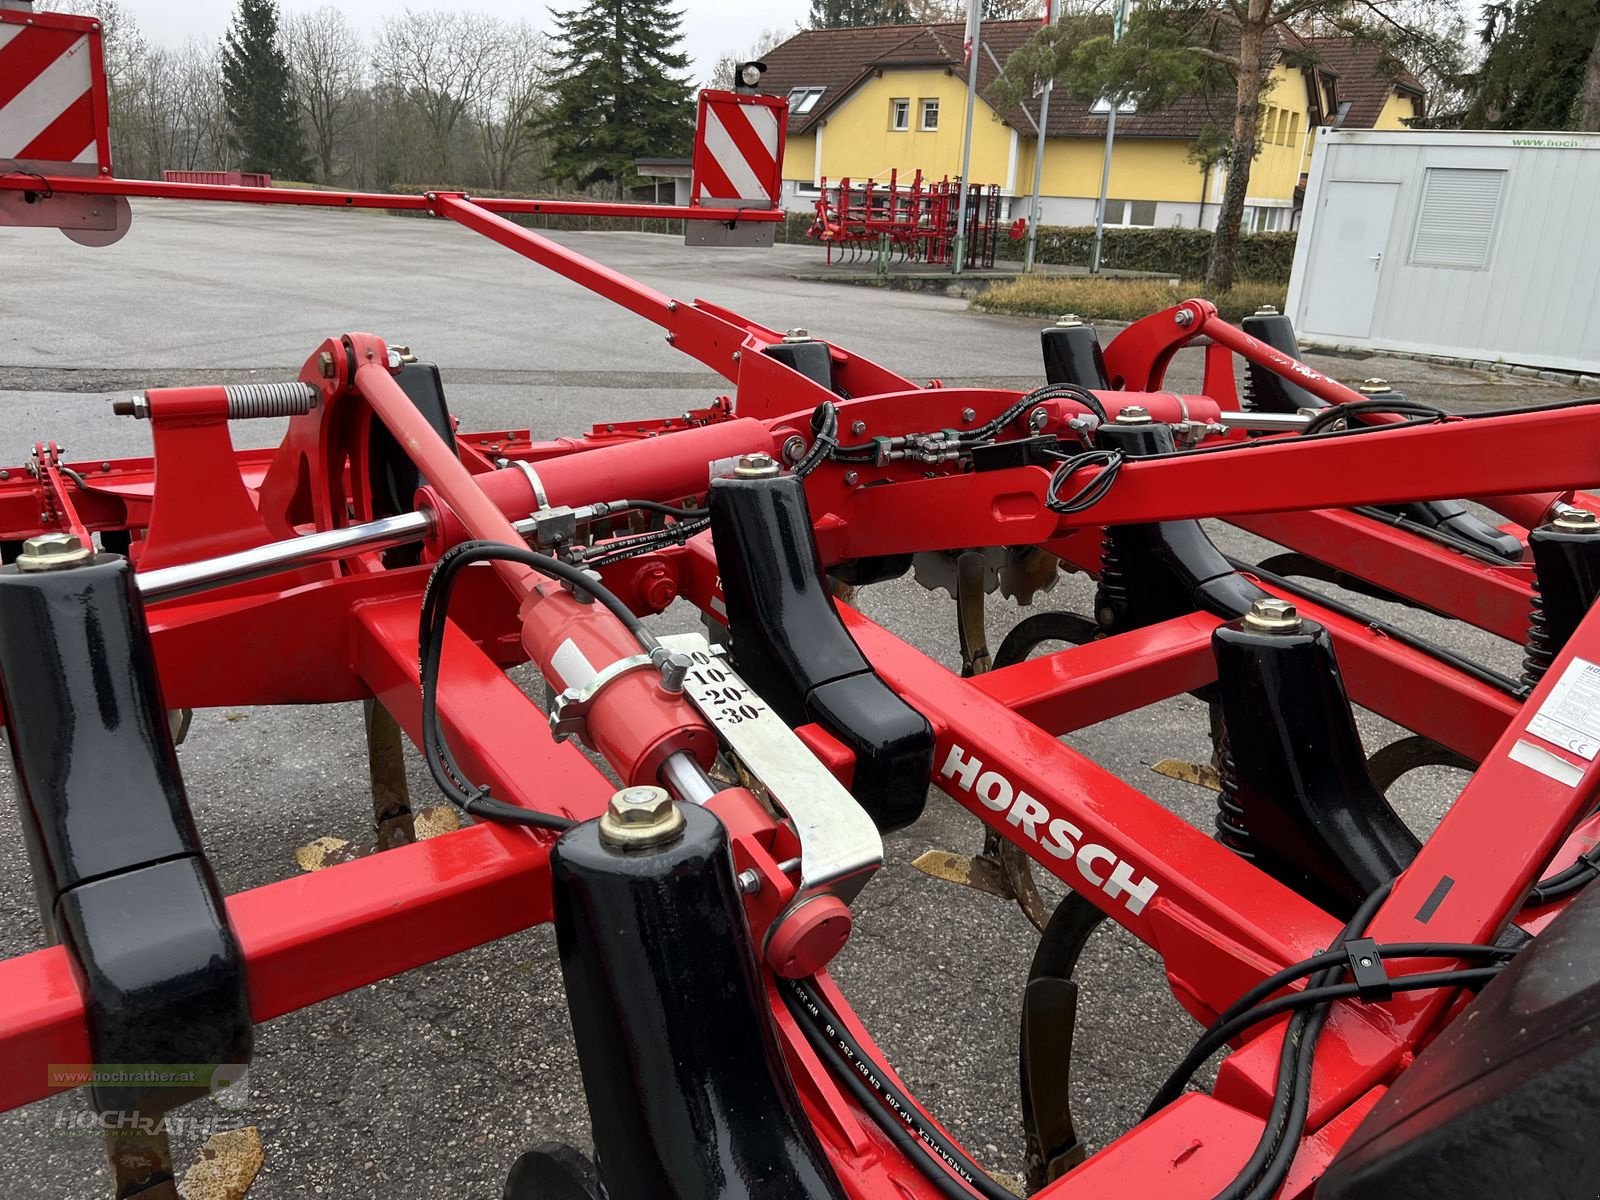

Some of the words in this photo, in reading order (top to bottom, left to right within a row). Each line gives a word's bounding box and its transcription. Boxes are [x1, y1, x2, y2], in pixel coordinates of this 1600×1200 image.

[941, 744, 1159, 917] HORSCH
[807, 1003, 819, 1017] WP
[838, 1040, 854, 1060] 2SC
[855, 1060, 869, 1076] 857
[868, 1075, 881, 1090] EN
[885, 1093, 901, 1111] 208
[899, 1111, 914, 1124] KP
[918, 1127, 973, 1184] HANSA-FLEX
